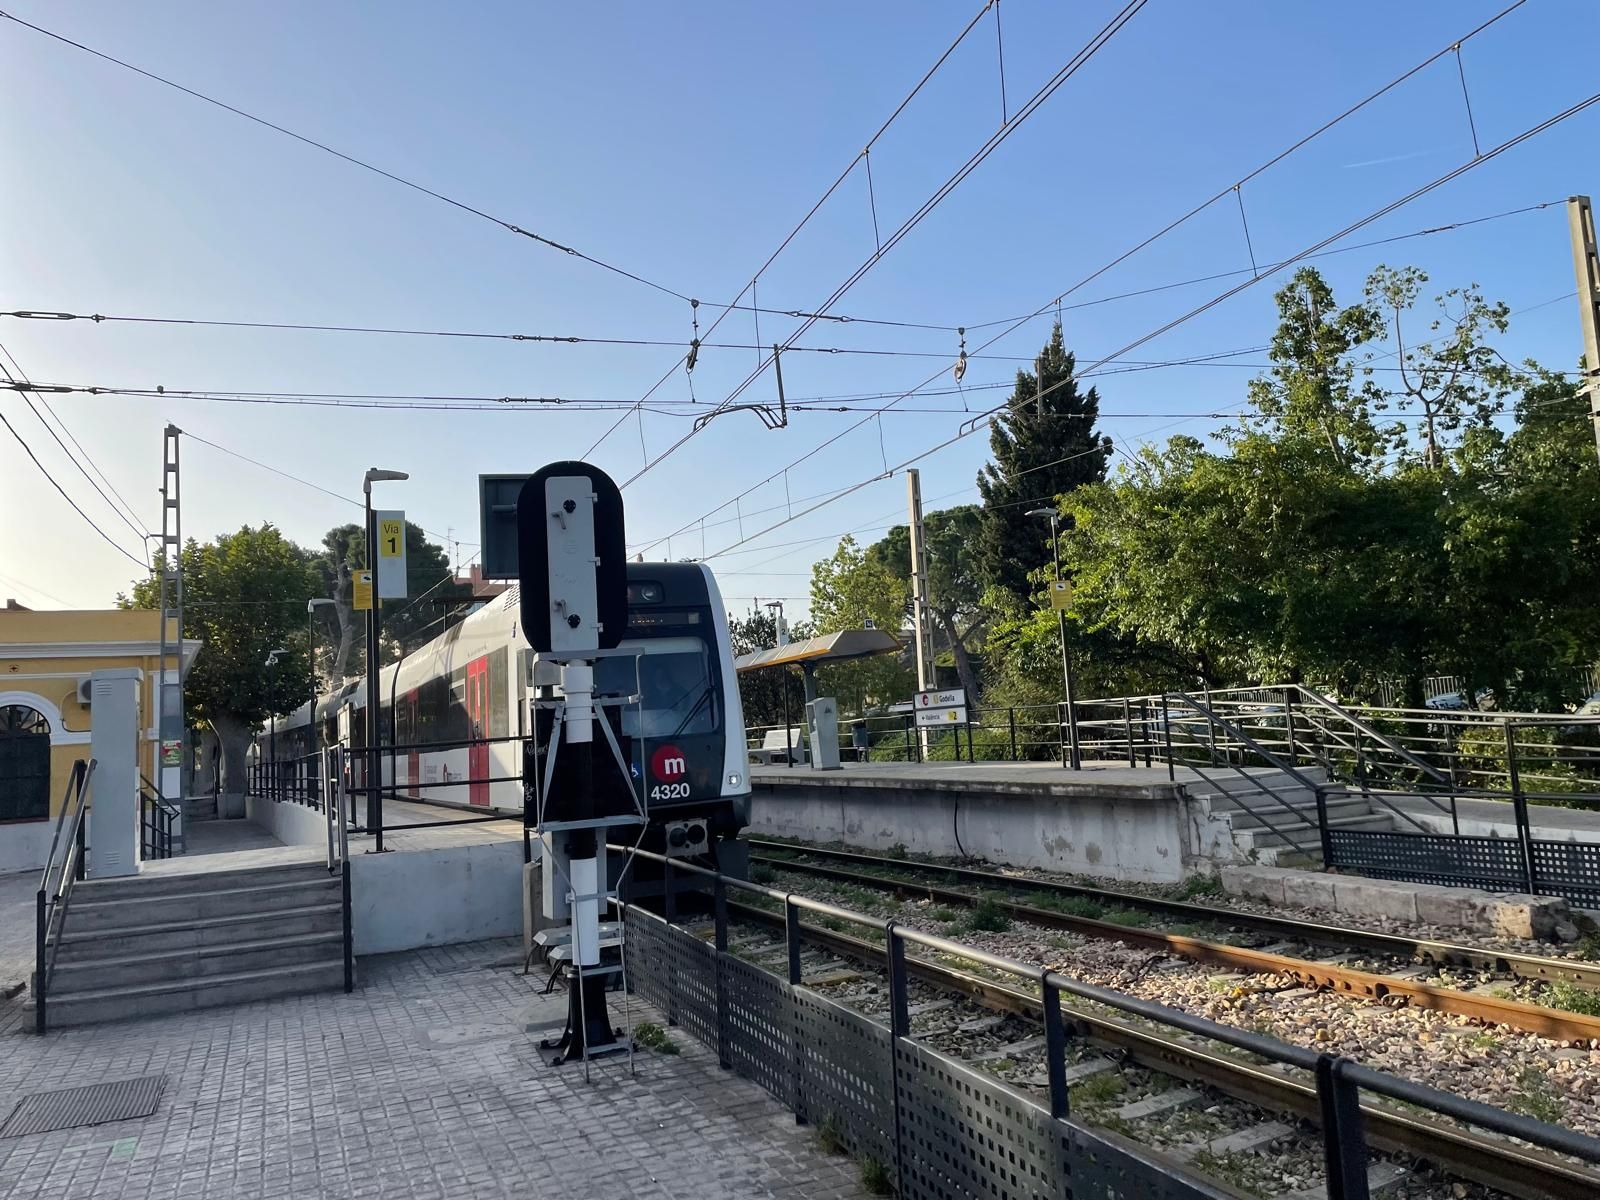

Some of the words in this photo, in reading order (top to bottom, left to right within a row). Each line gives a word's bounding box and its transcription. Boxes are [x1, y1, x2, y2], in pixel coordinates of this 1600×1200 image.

[383, 524, 399, 534] Via
[387, 537, 395, 553] 1
[664, 757, 685, 775] m
[651, 783, 690, 800] 4320
